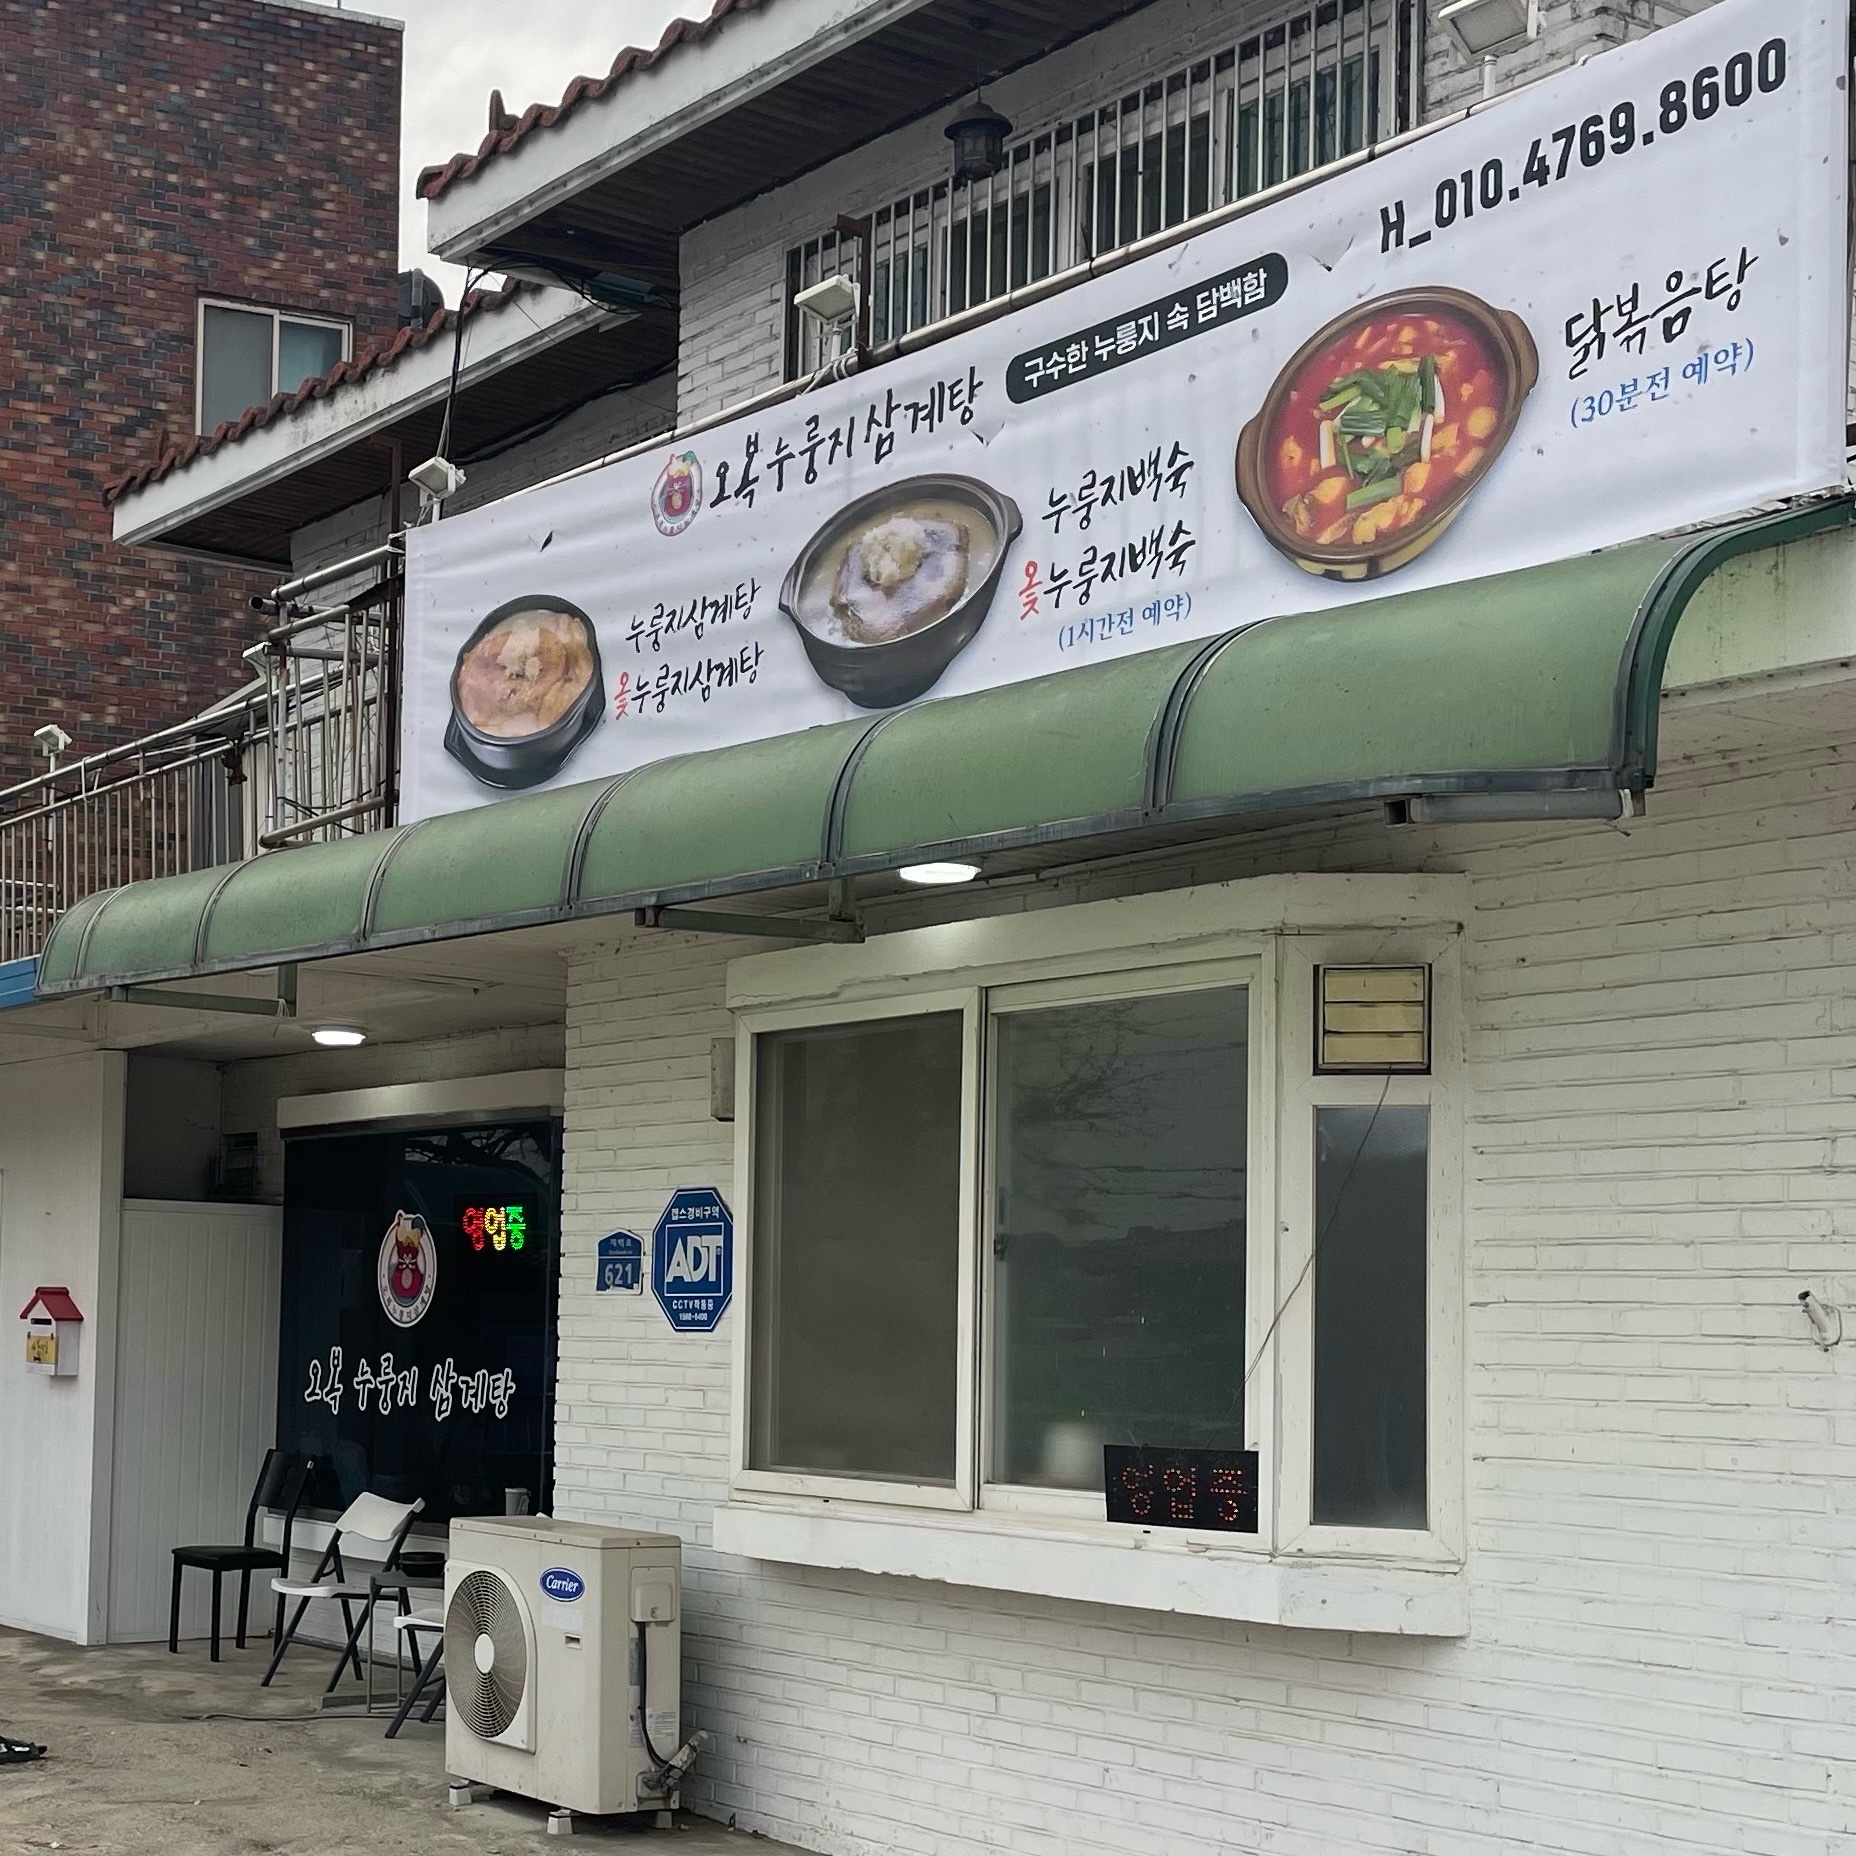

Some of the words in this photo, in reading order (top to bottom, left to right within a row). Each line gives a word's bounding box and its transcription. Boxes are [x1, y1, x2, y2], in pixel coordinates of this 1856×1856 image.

[1023, 341, 1089, 388] 구수한
[1094, 311, 1160, 361] 누룽지
[1166, 302, 1190, 331] 속
[1196, 268, 1267, 321] 담백함
[1565, 247, 1759, 380] 닭볶음탕
[1570, 366, 1671, 428] (30분전
[1682, 338, 1756, 387] 예약)
[1041, 441, 1195, 534] 누룽지백숙
[625, 578, 762, 654] 누룽지삼계탕
[1058, 610, 1134, 652] (1시간전
[1142, 591, 1194, 628] 예약)
[463, 1206, 526, 1251] 영업중
[666, 1235, 722, 1282] ADT
[604, 1263, 632, 1285] 621
[304, 1346, 344, 1414] 오복
[353, 1352, 418, 1415] 누룽지
[430, 1357, 516, 1421] 삼계탕
[1122, 1464, 1248, 1522] 영업중
[546, 1574, 579, 1593] Carrier
